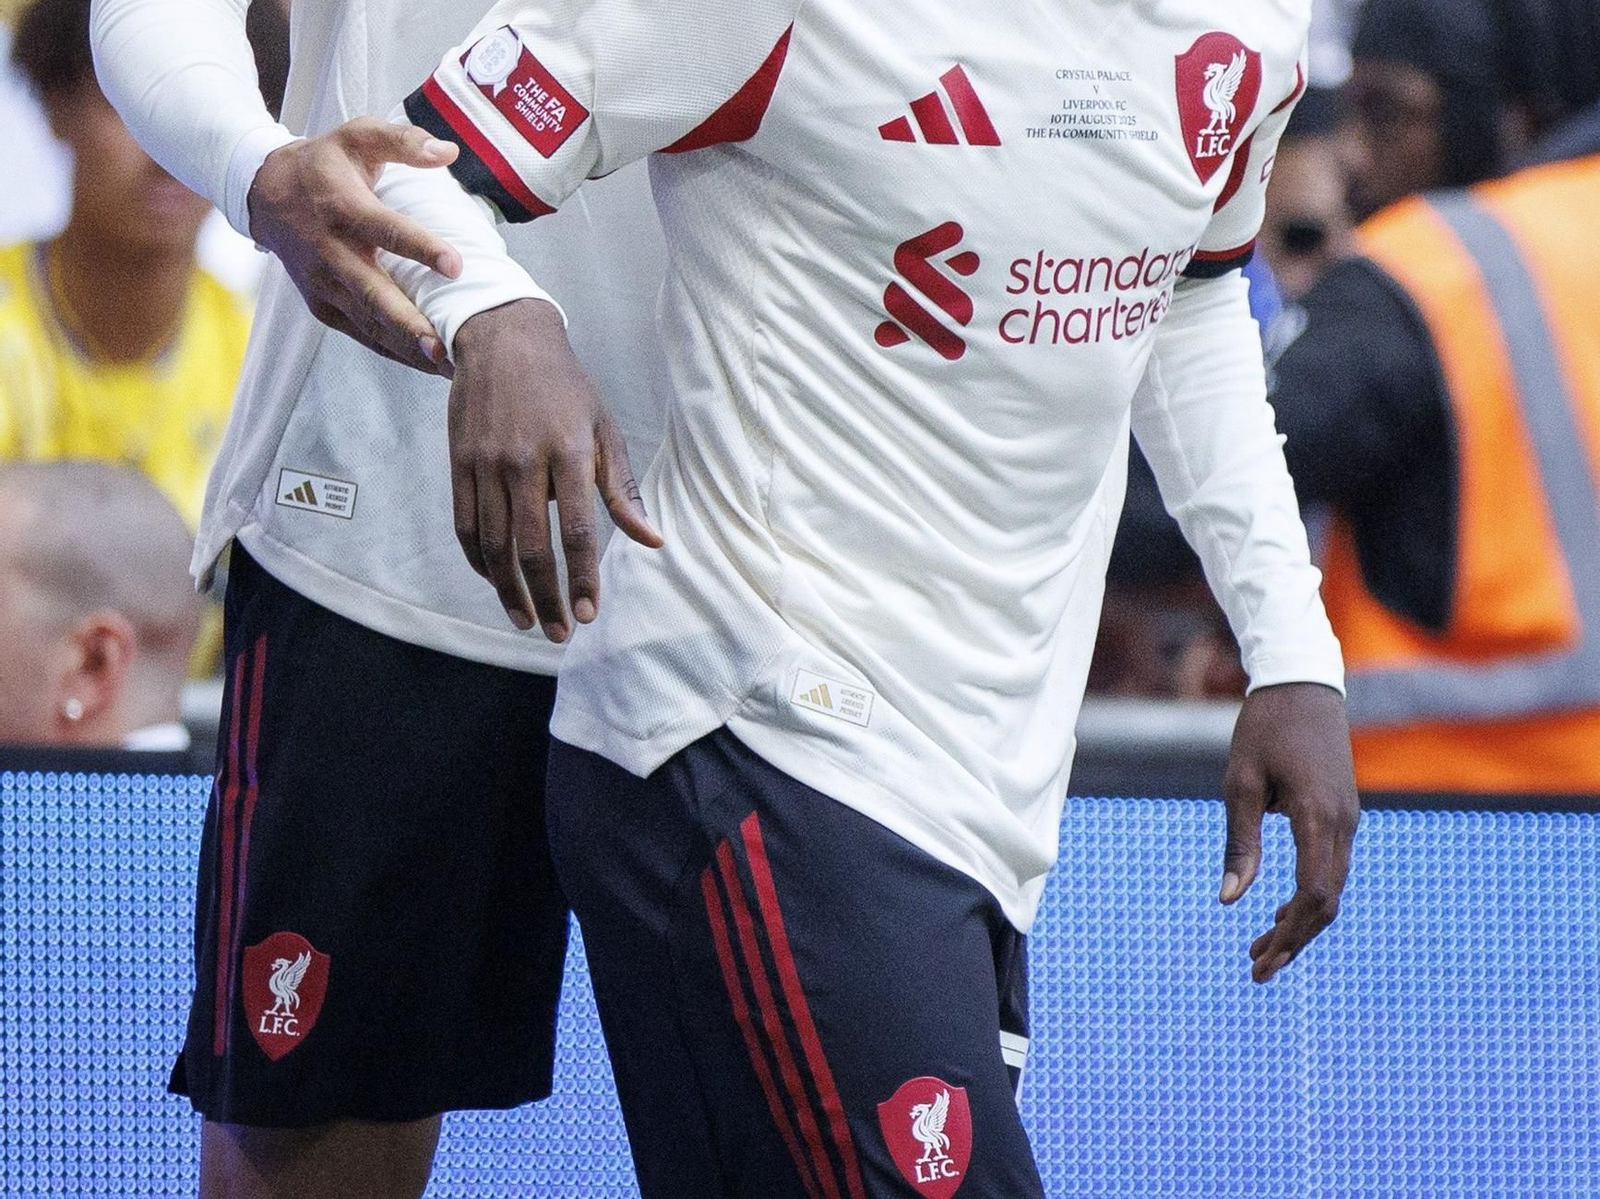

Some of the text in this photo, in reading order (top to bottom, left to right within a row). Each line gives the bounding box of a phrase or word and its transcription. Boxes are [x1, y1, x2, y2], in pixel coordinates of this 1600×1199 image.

[1055, 69, 1132, 81] CRYSTAL PALACE
[513, 83, 563, 133] COMMUNITY
[524, 77, 567, 122] THE FA
[1116, 101, 1127, 110] FC
[514, 100, 546, 132] SHIELD
[1050, 114, 1077, 124] 10TH
[1078, 114, 1116, 124] AUGUST
[1026, 128, 1047, 138] THE
[1048, 128, 1060, 138] FA
[1062, 128, 1127, 140] COMMUNITY
[999, 290, 1170, 344] chartere
